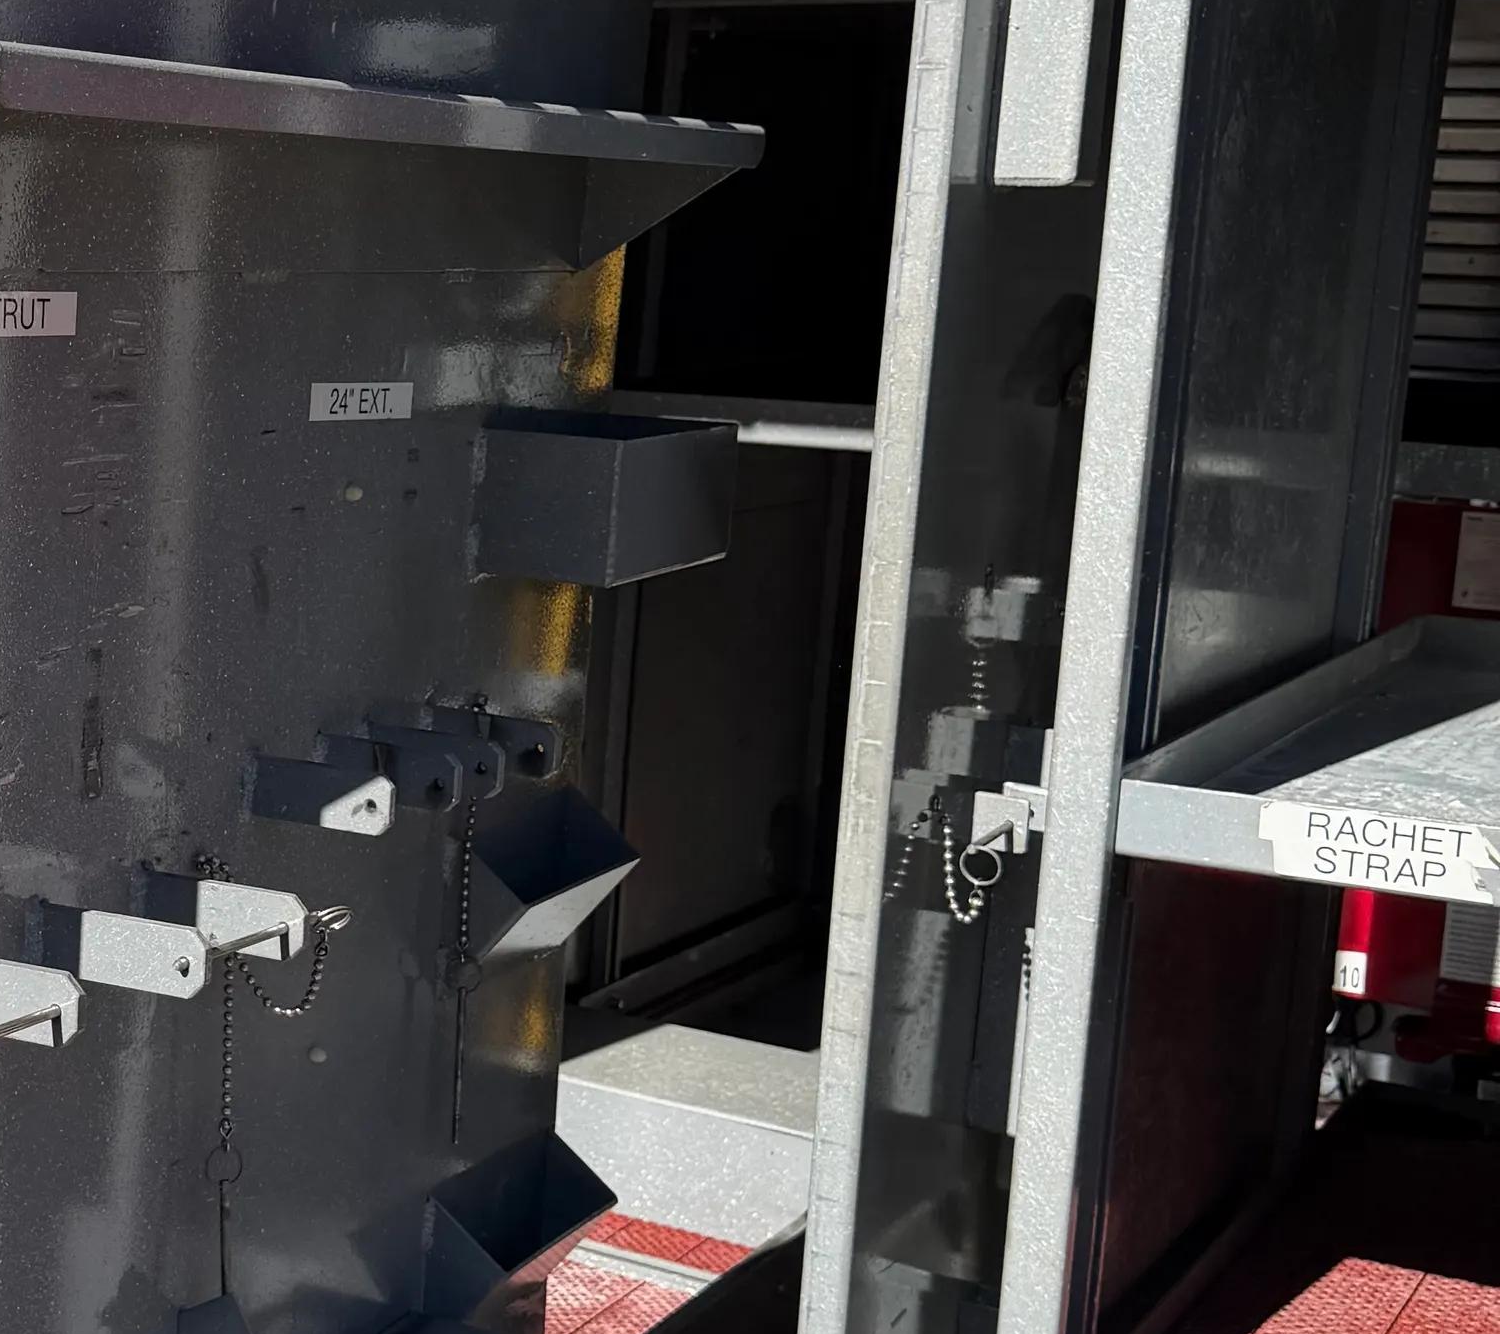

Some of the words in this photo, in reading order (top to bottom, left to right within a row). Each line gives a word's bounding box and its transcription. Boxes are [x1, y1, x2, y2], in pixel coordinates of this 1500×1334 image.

[328, 387, 355, 415] 24"
[358, 387, 393, 414] EXT.
[1306, 811, 1473, 858] RACHET
[1313, 846, 1447, 888] STRAP
[1338, 964, 1361, 989] 10
